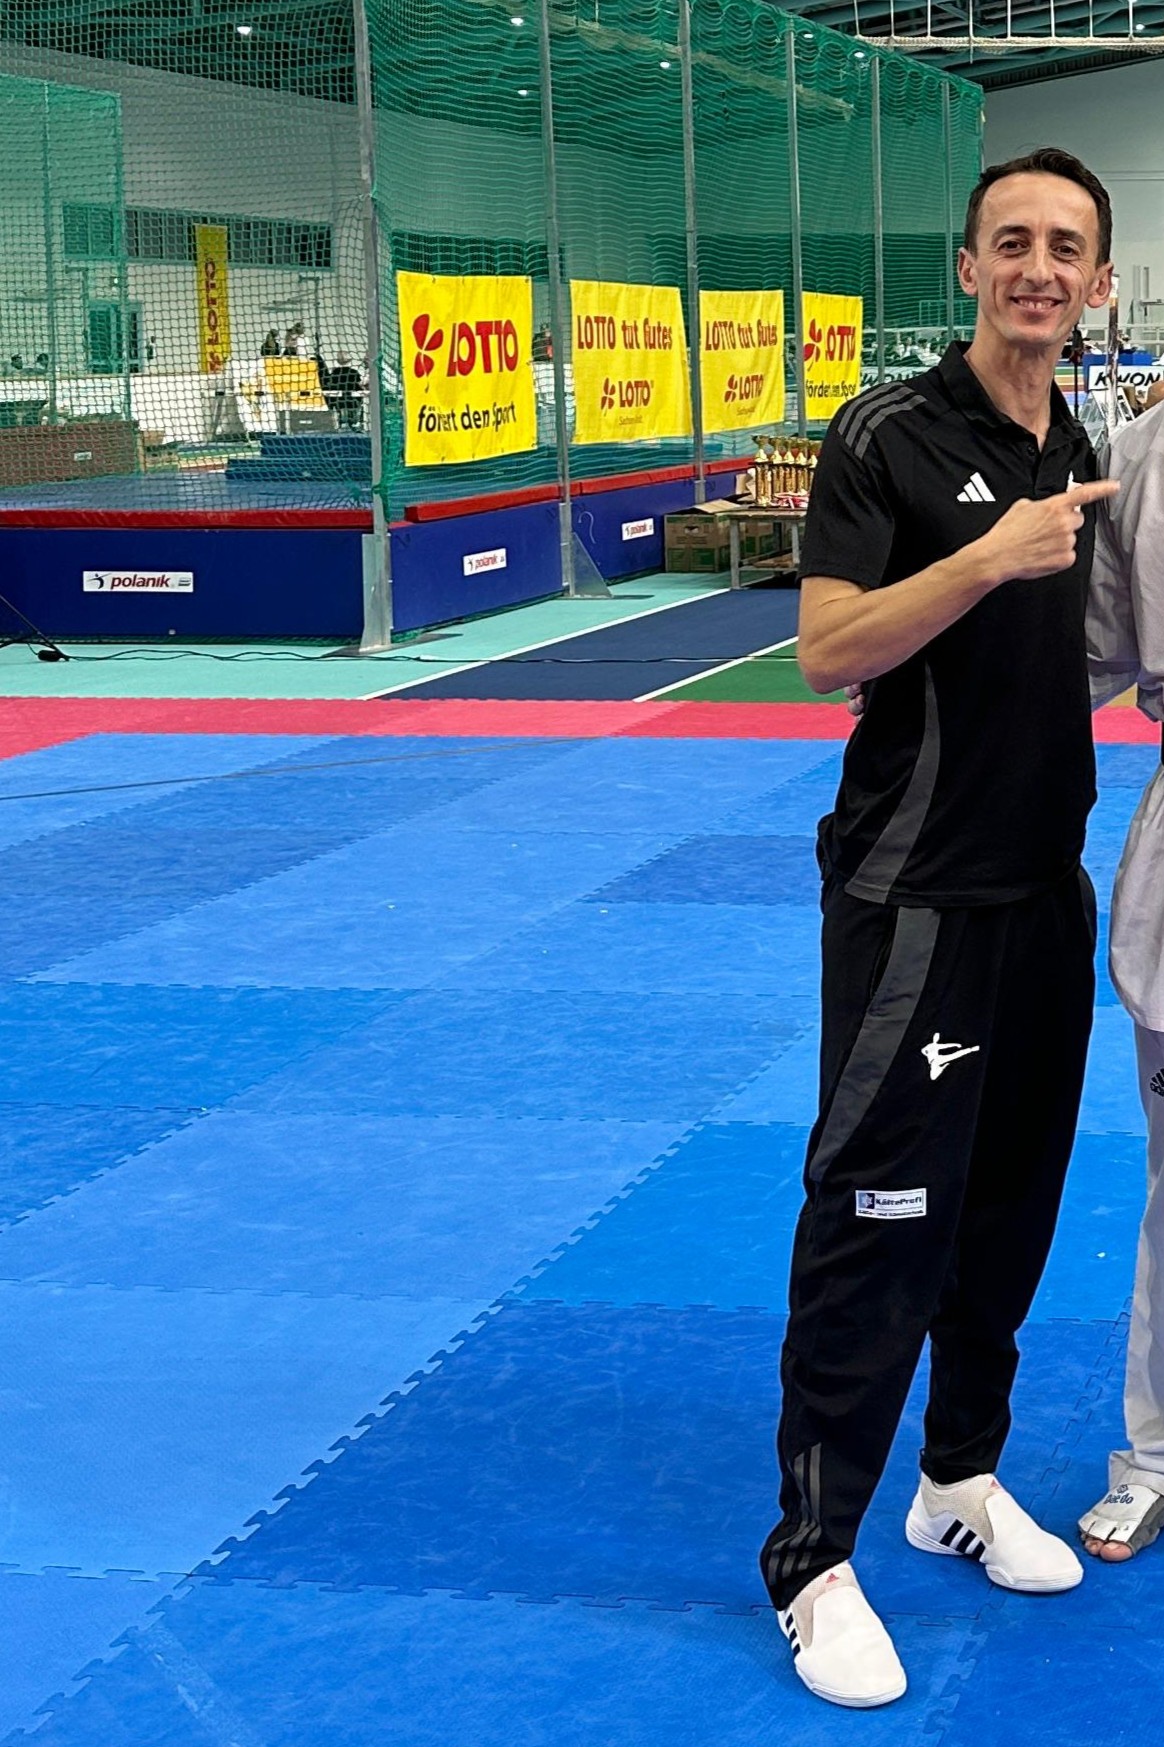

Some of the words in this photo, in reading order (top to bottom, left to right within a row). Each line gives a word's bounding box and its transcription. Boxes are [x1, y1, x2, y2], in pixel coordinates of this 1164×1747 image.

[204, 261, 220, 345] LOTTO
[447, 319, 518, 377] LOTTO
[577, 315, 616, 349] LOTTO
[622, 320, 640, 349] tut
[643, 317, 673, 350] Gutes
[705, 320, 736, 351] LOTTO
[737, 322, 756, 349] tut
[825, 325, 856, 362] OTTO
[618, 380, 651, 408] LOTTO
[739, 374, 764, 400] LOTTO
[461, 403, 490, 430] den
[110, 574, 171, 590] polanik
